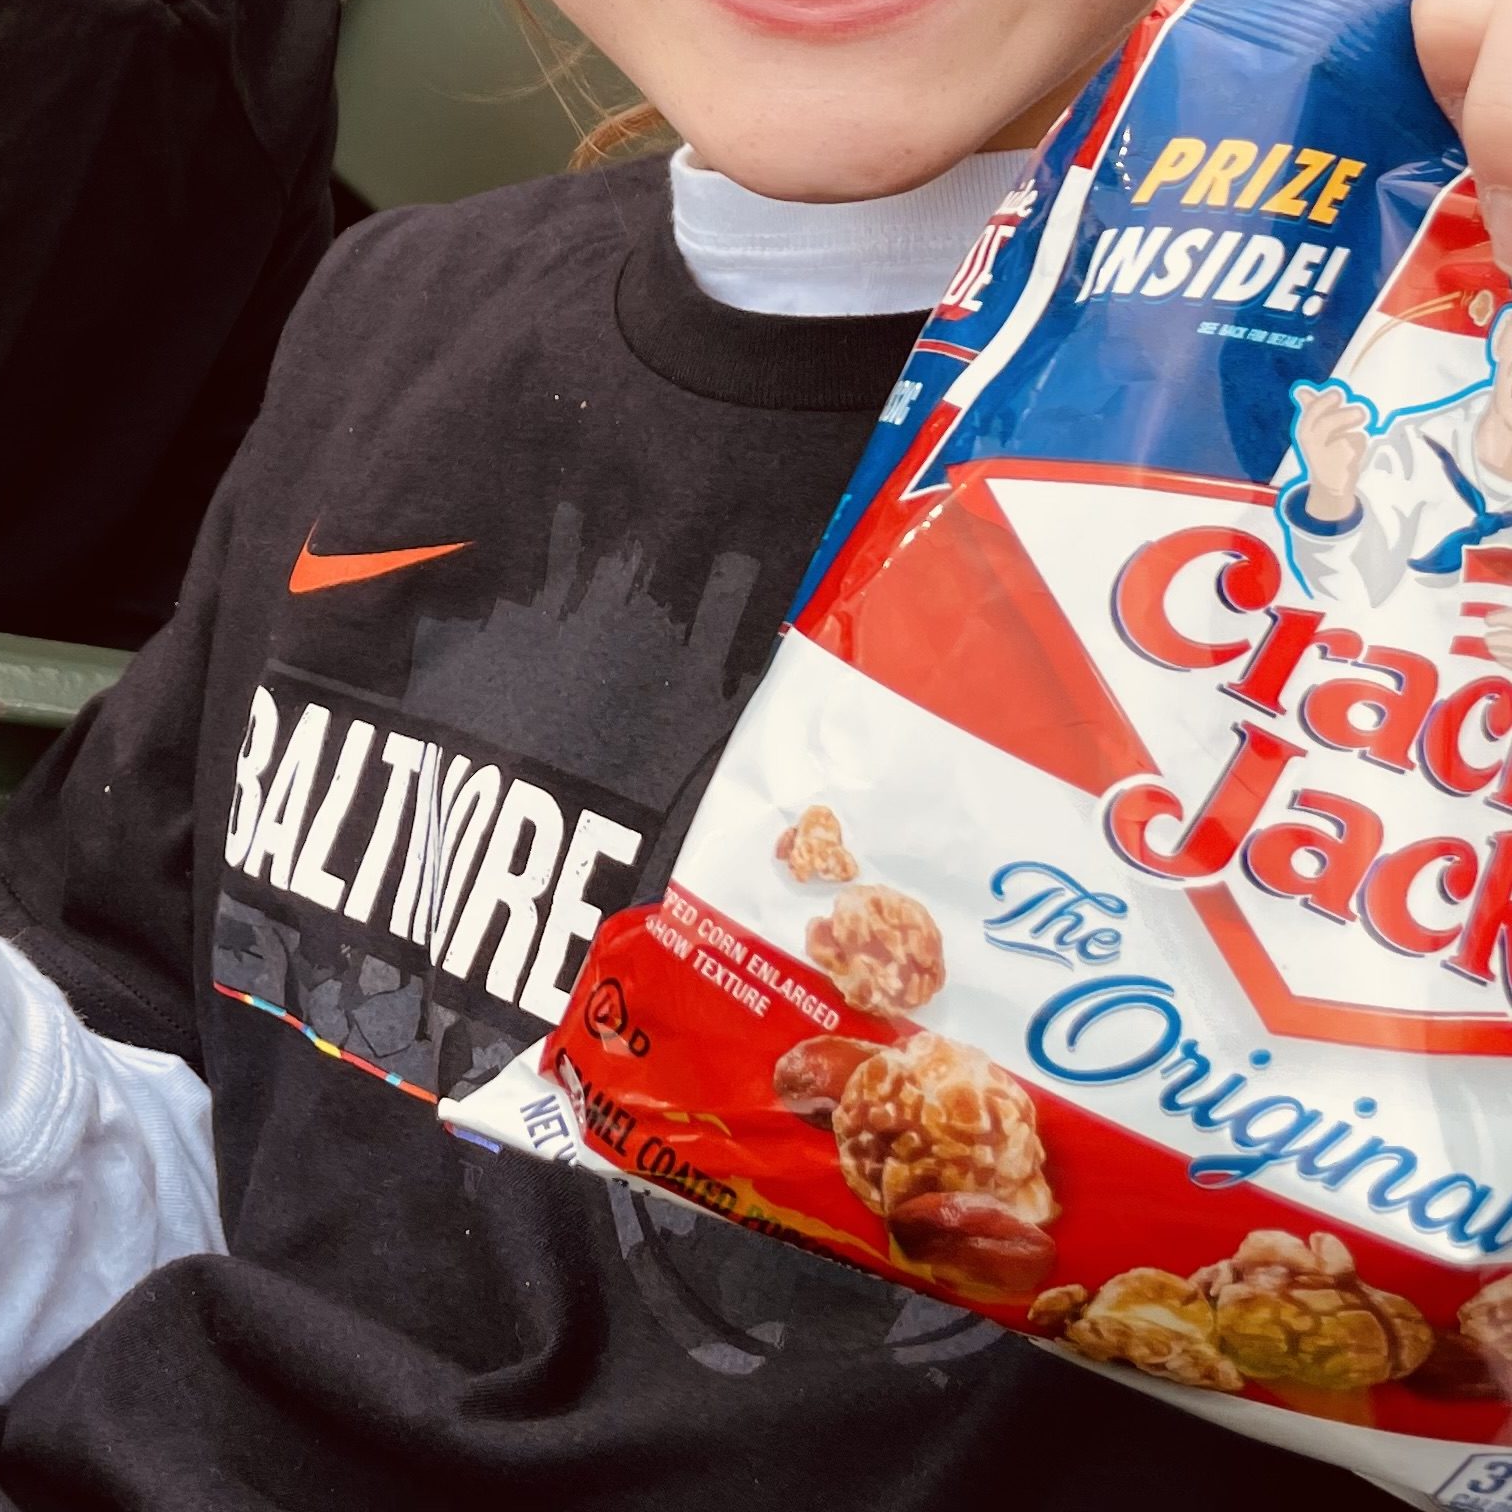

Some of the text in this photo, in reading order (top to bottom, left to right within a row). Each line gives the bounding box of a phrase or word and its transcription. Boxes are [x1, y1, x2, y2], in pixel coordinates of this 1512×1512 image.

[1131, 137, 1368, 225] PRIZE
[1075, 226, 1352, 317] INSIDE!
[983, 860, 1129, 971] The
[692, 948, 772, 1019] TEXTURE
[696, 917, 749, 963] CORN
[745, 952, 840, 1032] ENLARGED
[520, 1093, 570, 1150] NET
